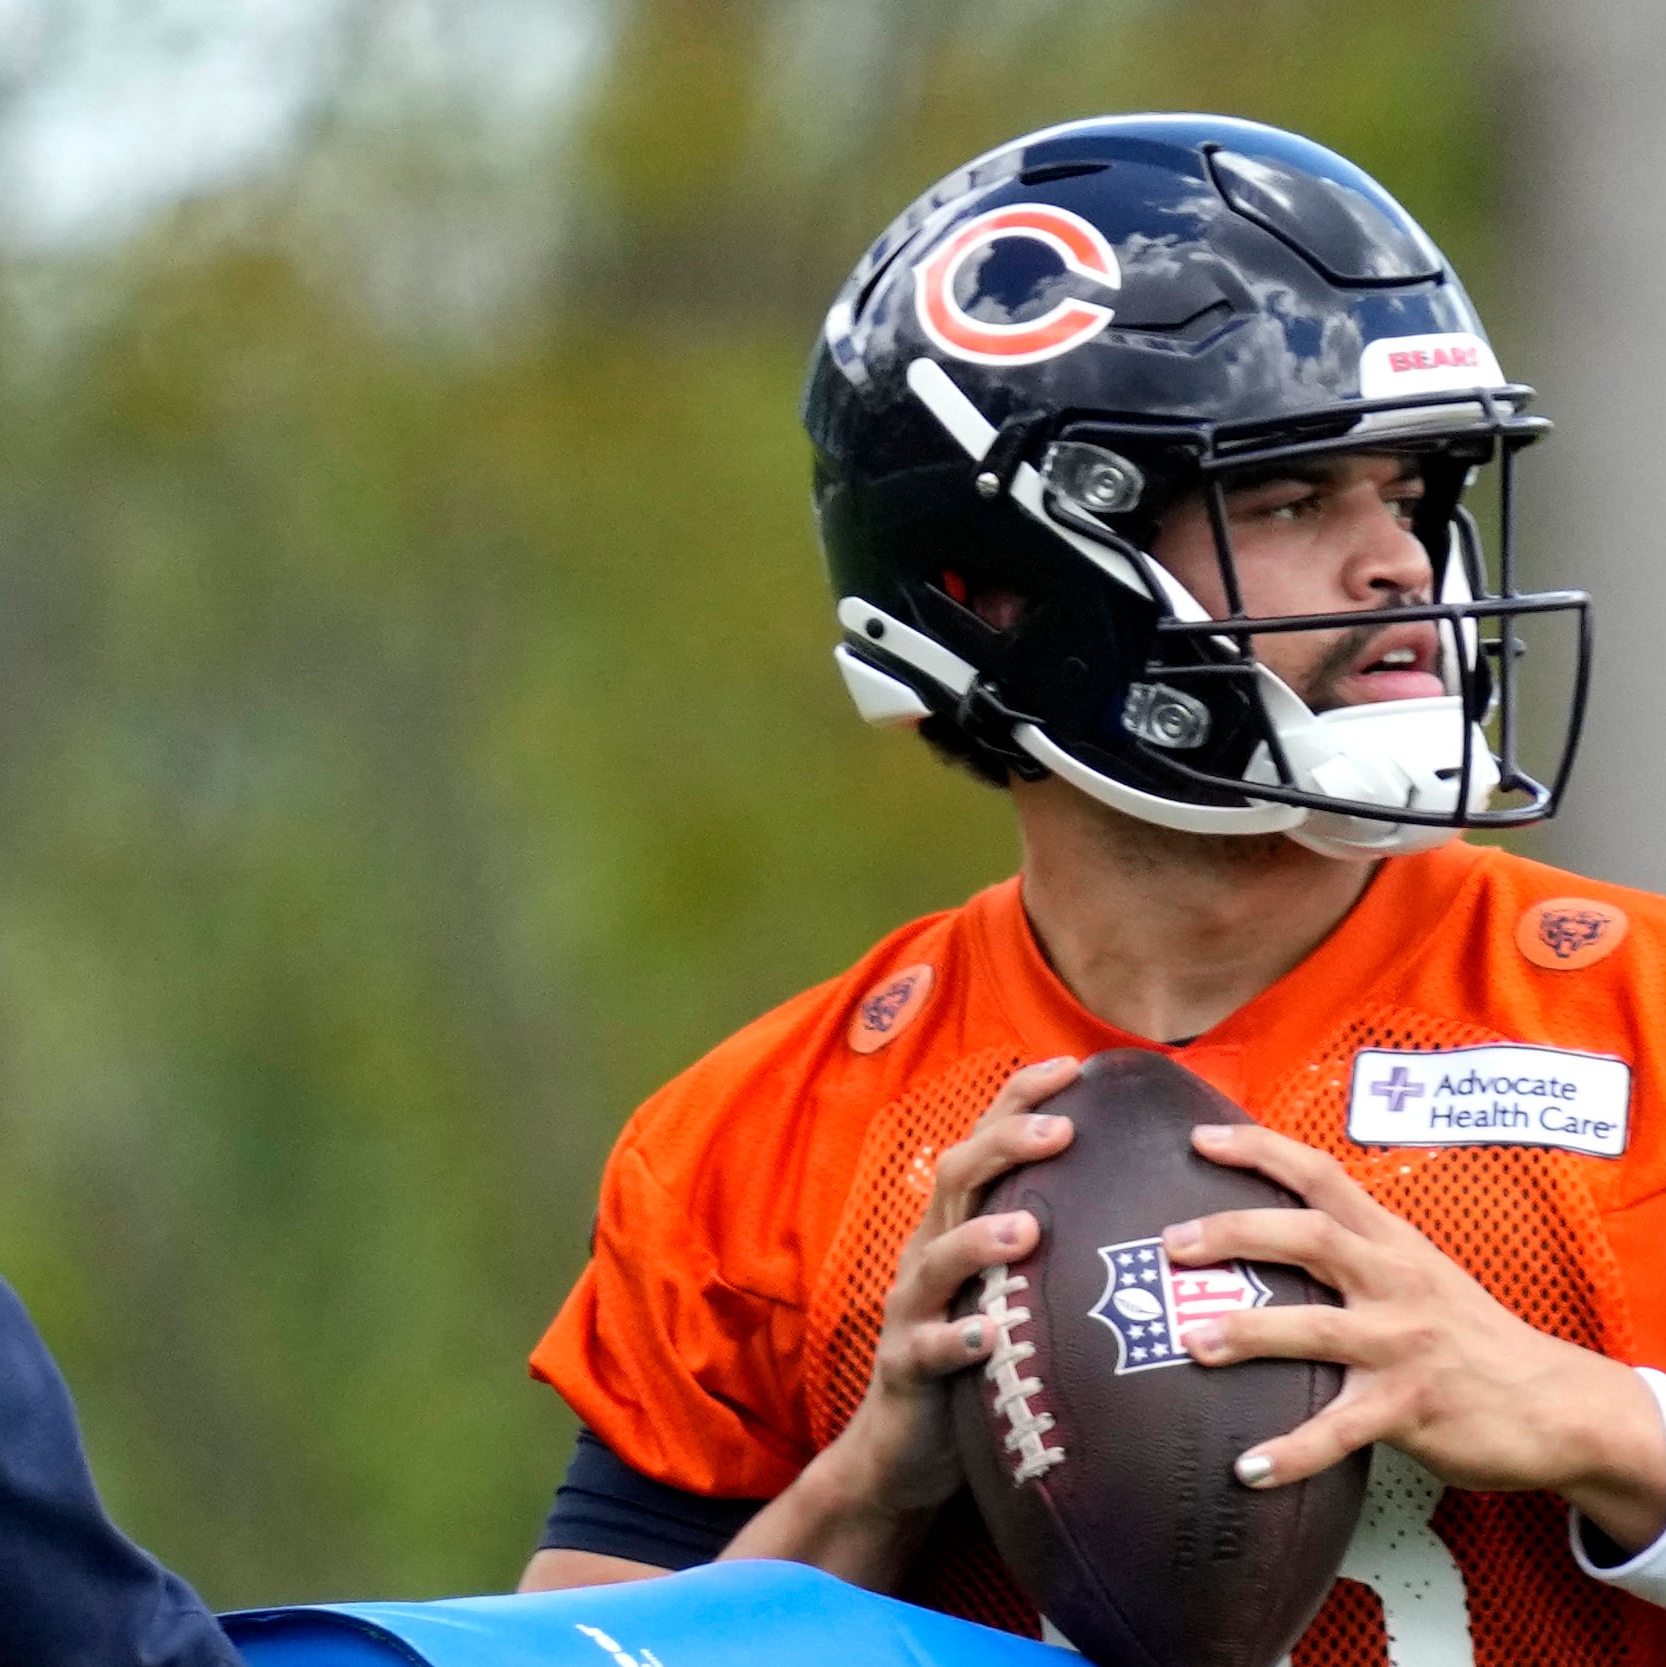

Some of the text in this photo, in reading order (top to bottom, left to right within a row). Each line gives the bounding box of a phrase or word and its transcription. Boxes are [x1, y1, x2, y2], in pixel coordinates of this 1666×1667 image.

[1434, 1068, 1578, 1101] Advocate
[1430, 1101, 1618, 1139] Health Care
